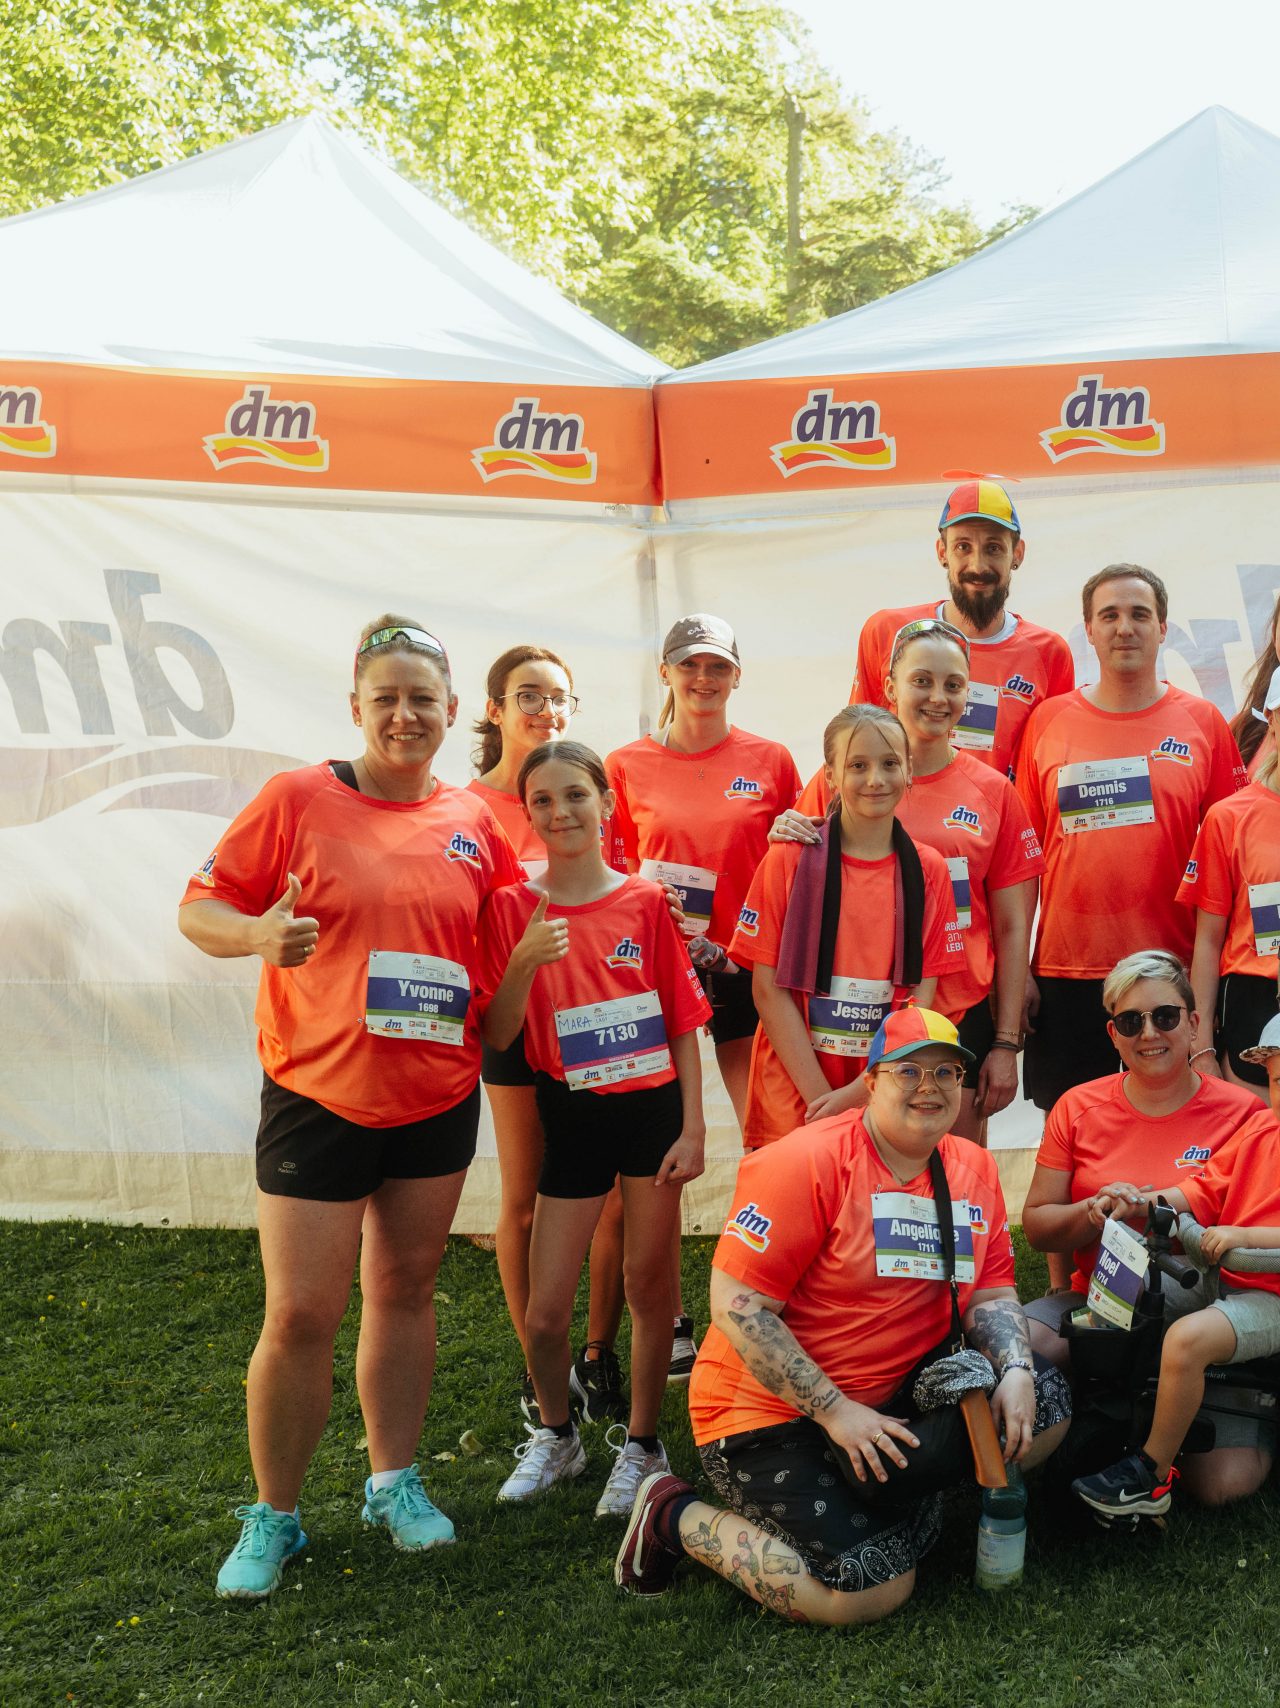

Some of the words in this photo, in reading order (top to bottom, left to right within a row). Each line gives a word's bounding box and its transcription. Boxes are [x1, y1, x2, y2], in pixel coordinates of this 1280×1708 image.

[0, 390, 37, 424] m
[1065, 380, 1145, 429] dm
[230, 391, 311, 439] dm
[797, 395, 876, 442] dm
[499, 403, 580, 452] dm
[1007, 676, 1034, 694] dm
[1161, 738, 1188, 755] dm
[733, 778, 757, 791] dm
[1078, 781, 1127, 798] Dennis
[1095, 798, 1114, 806] 1716
[953, 807, 978, 825] dm
[452, 836, 478, 855] dm
[617, 940, 640, 957] dm
[398, 980, 454, 1002] Yvonne
[418, 1003, 438, 1013] 1698
[832, 1002, 882, 1020] Jessica
[558, 1016, 592, 1033] MARA
[851, 1023, 869, 1032] 1704
[595, 1023, 638, 1046] 7130
[1184, 1147, 1210, 1160] dm
[735, 1204, 772, 1234] dm
[890, 1219, 960, 1244] Angeliqe
[918, 1242, 935, 1253] 1711
[1099, 1249, 1121, 1277] Noel
[1096, 1270, 1109, 1286] 1714
